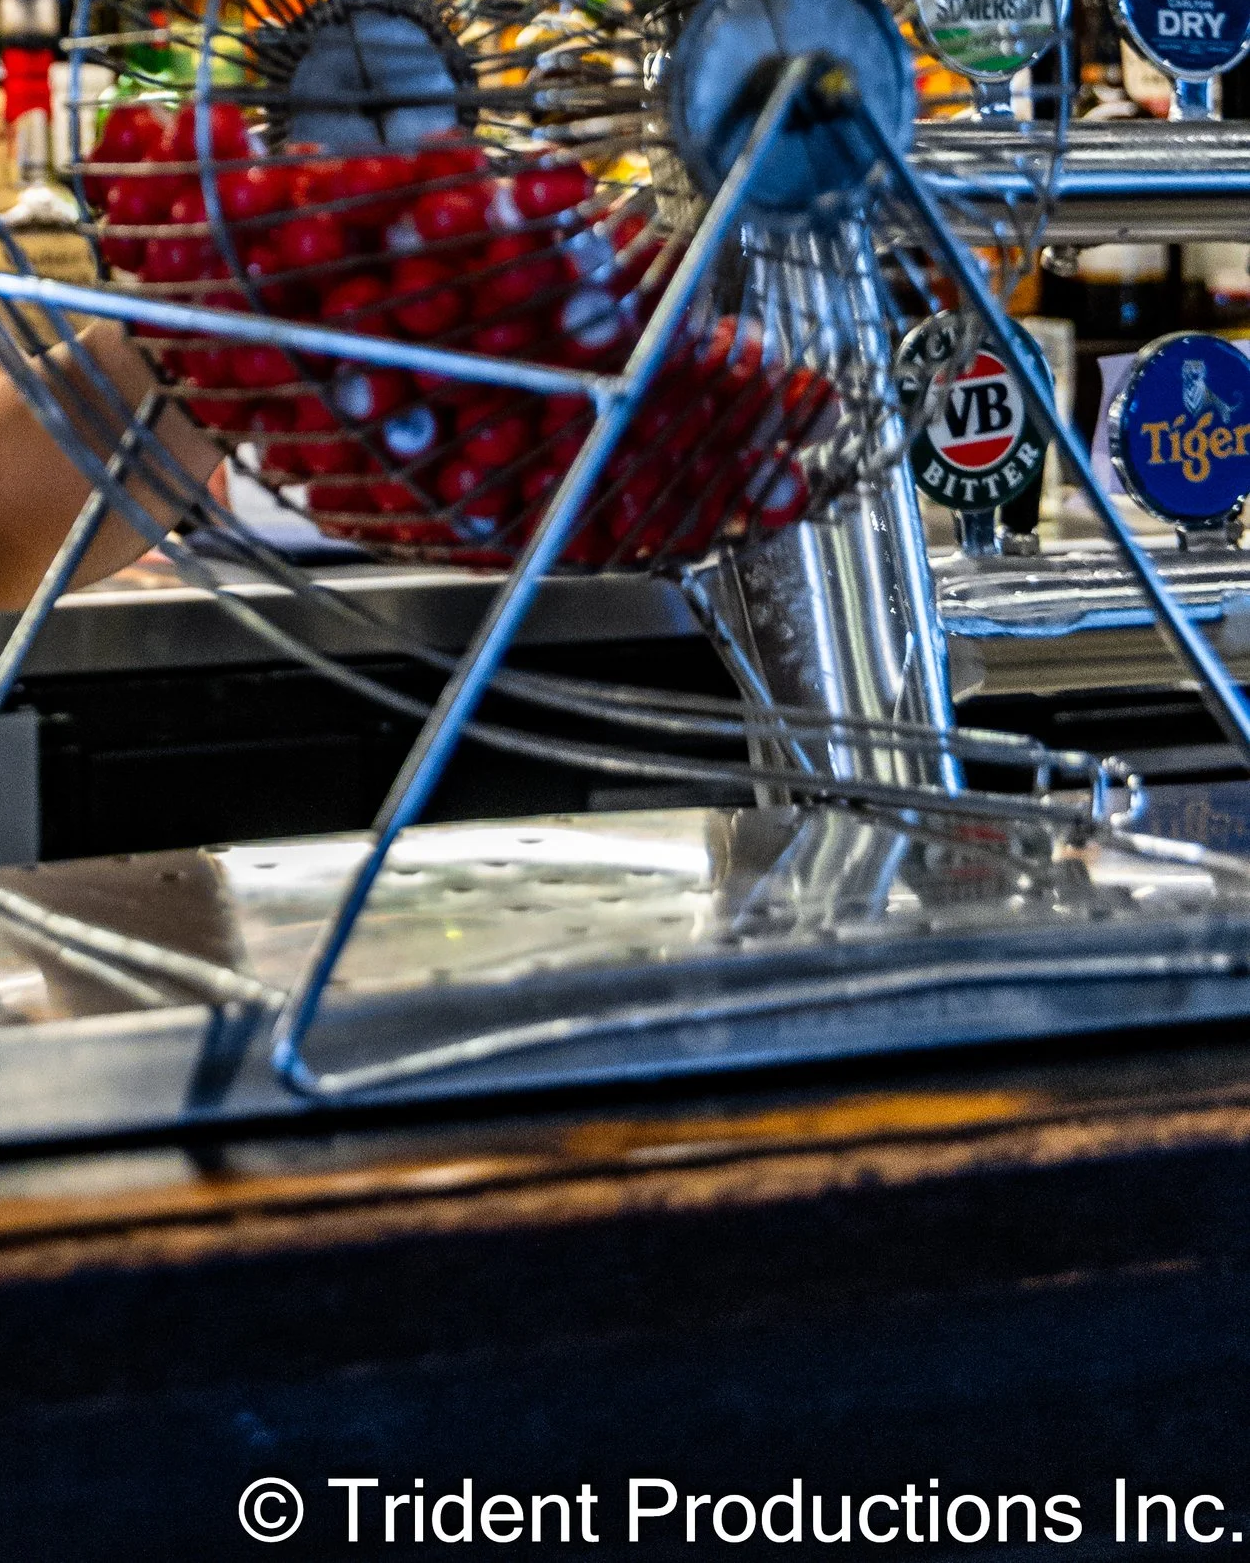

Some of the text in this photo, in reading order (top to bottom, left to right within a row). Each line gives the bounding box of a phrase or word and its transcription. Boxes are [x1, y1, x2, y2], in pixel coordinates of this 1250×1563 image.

[1157, 9, 1226, 39] DRY
[944, 382, 1013, 439] VB
[921, 441, 1041, 503] BITTER
[1140, 411, 1250, 483] Tiger
